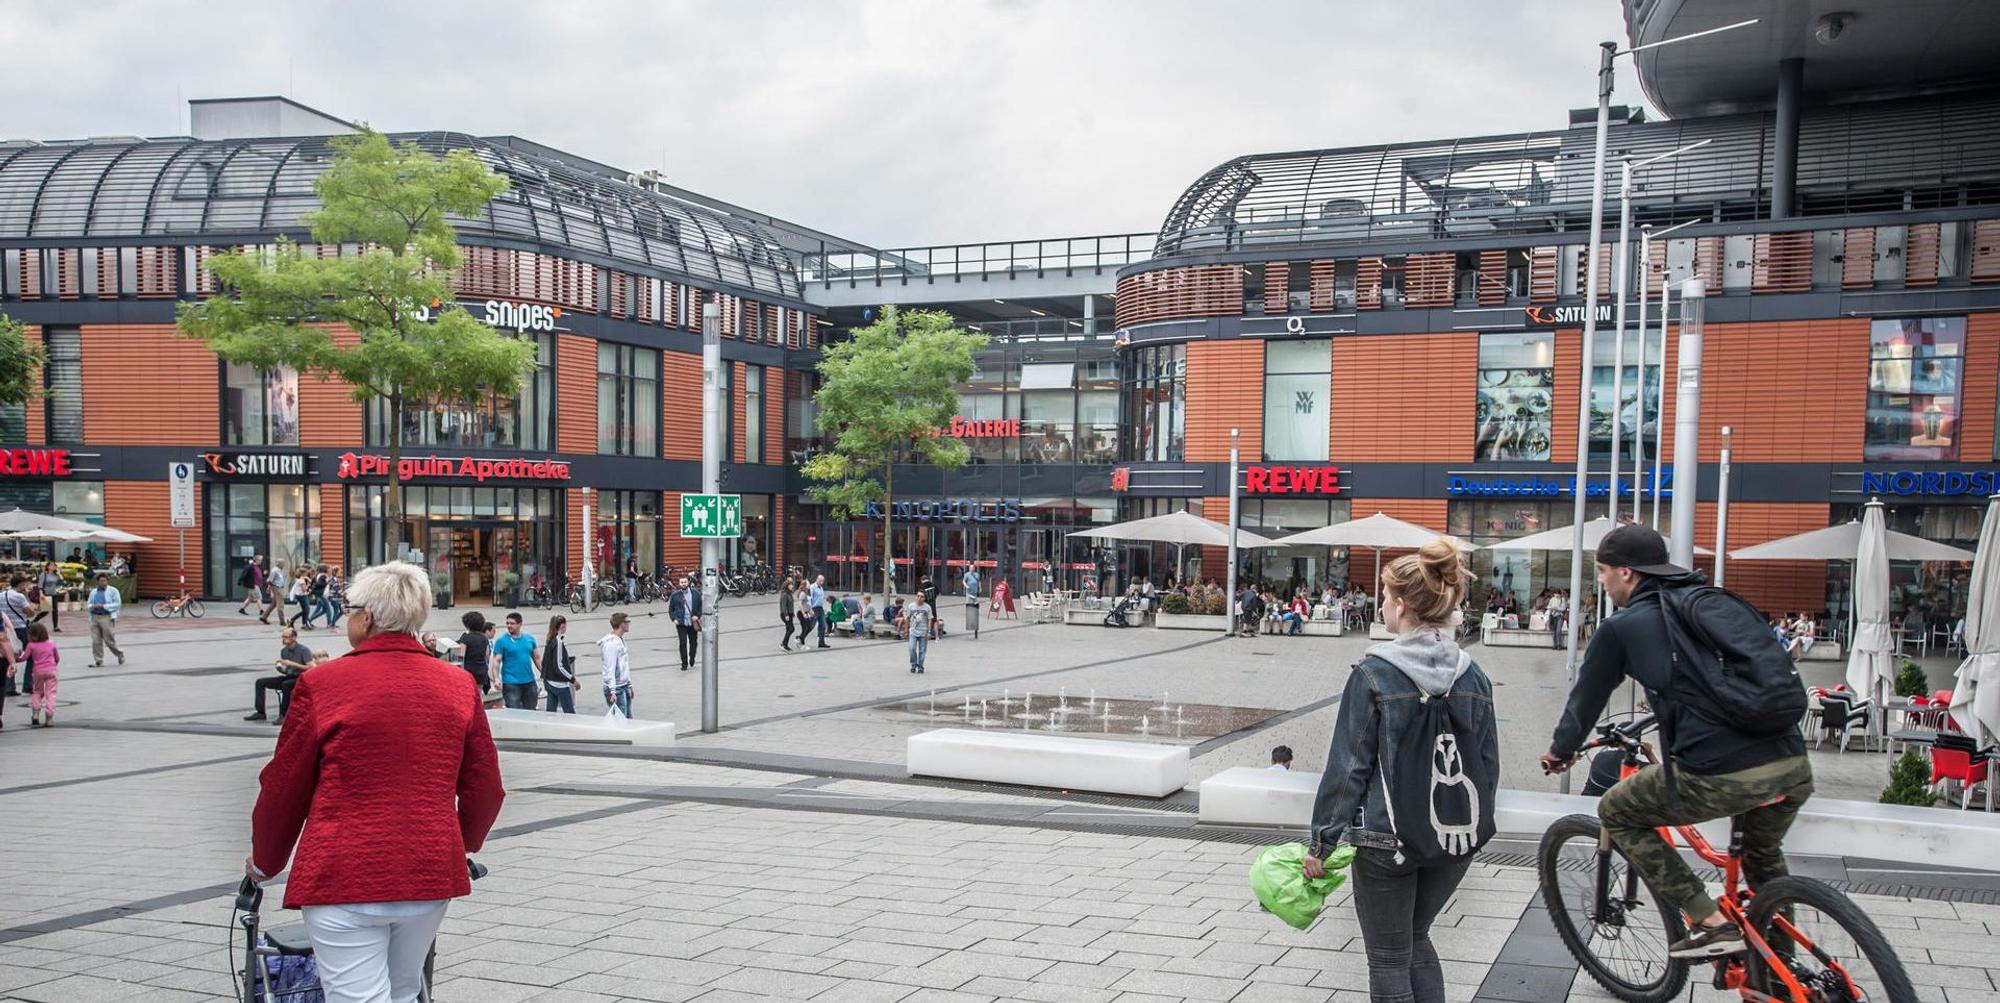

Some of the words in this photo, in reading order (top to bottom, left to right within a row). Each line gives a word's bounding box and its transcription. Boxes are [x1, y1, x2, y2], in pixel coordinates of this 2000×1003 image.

[237, 455, 303, 475] SATURN
[458, 457, 569, 482] Apotheke
[1246, 467, 1340, 494] REWE
[1450, 476, 1560, 496] Deutsche
[866, 499, 1023, 522] KNOPOLIS
